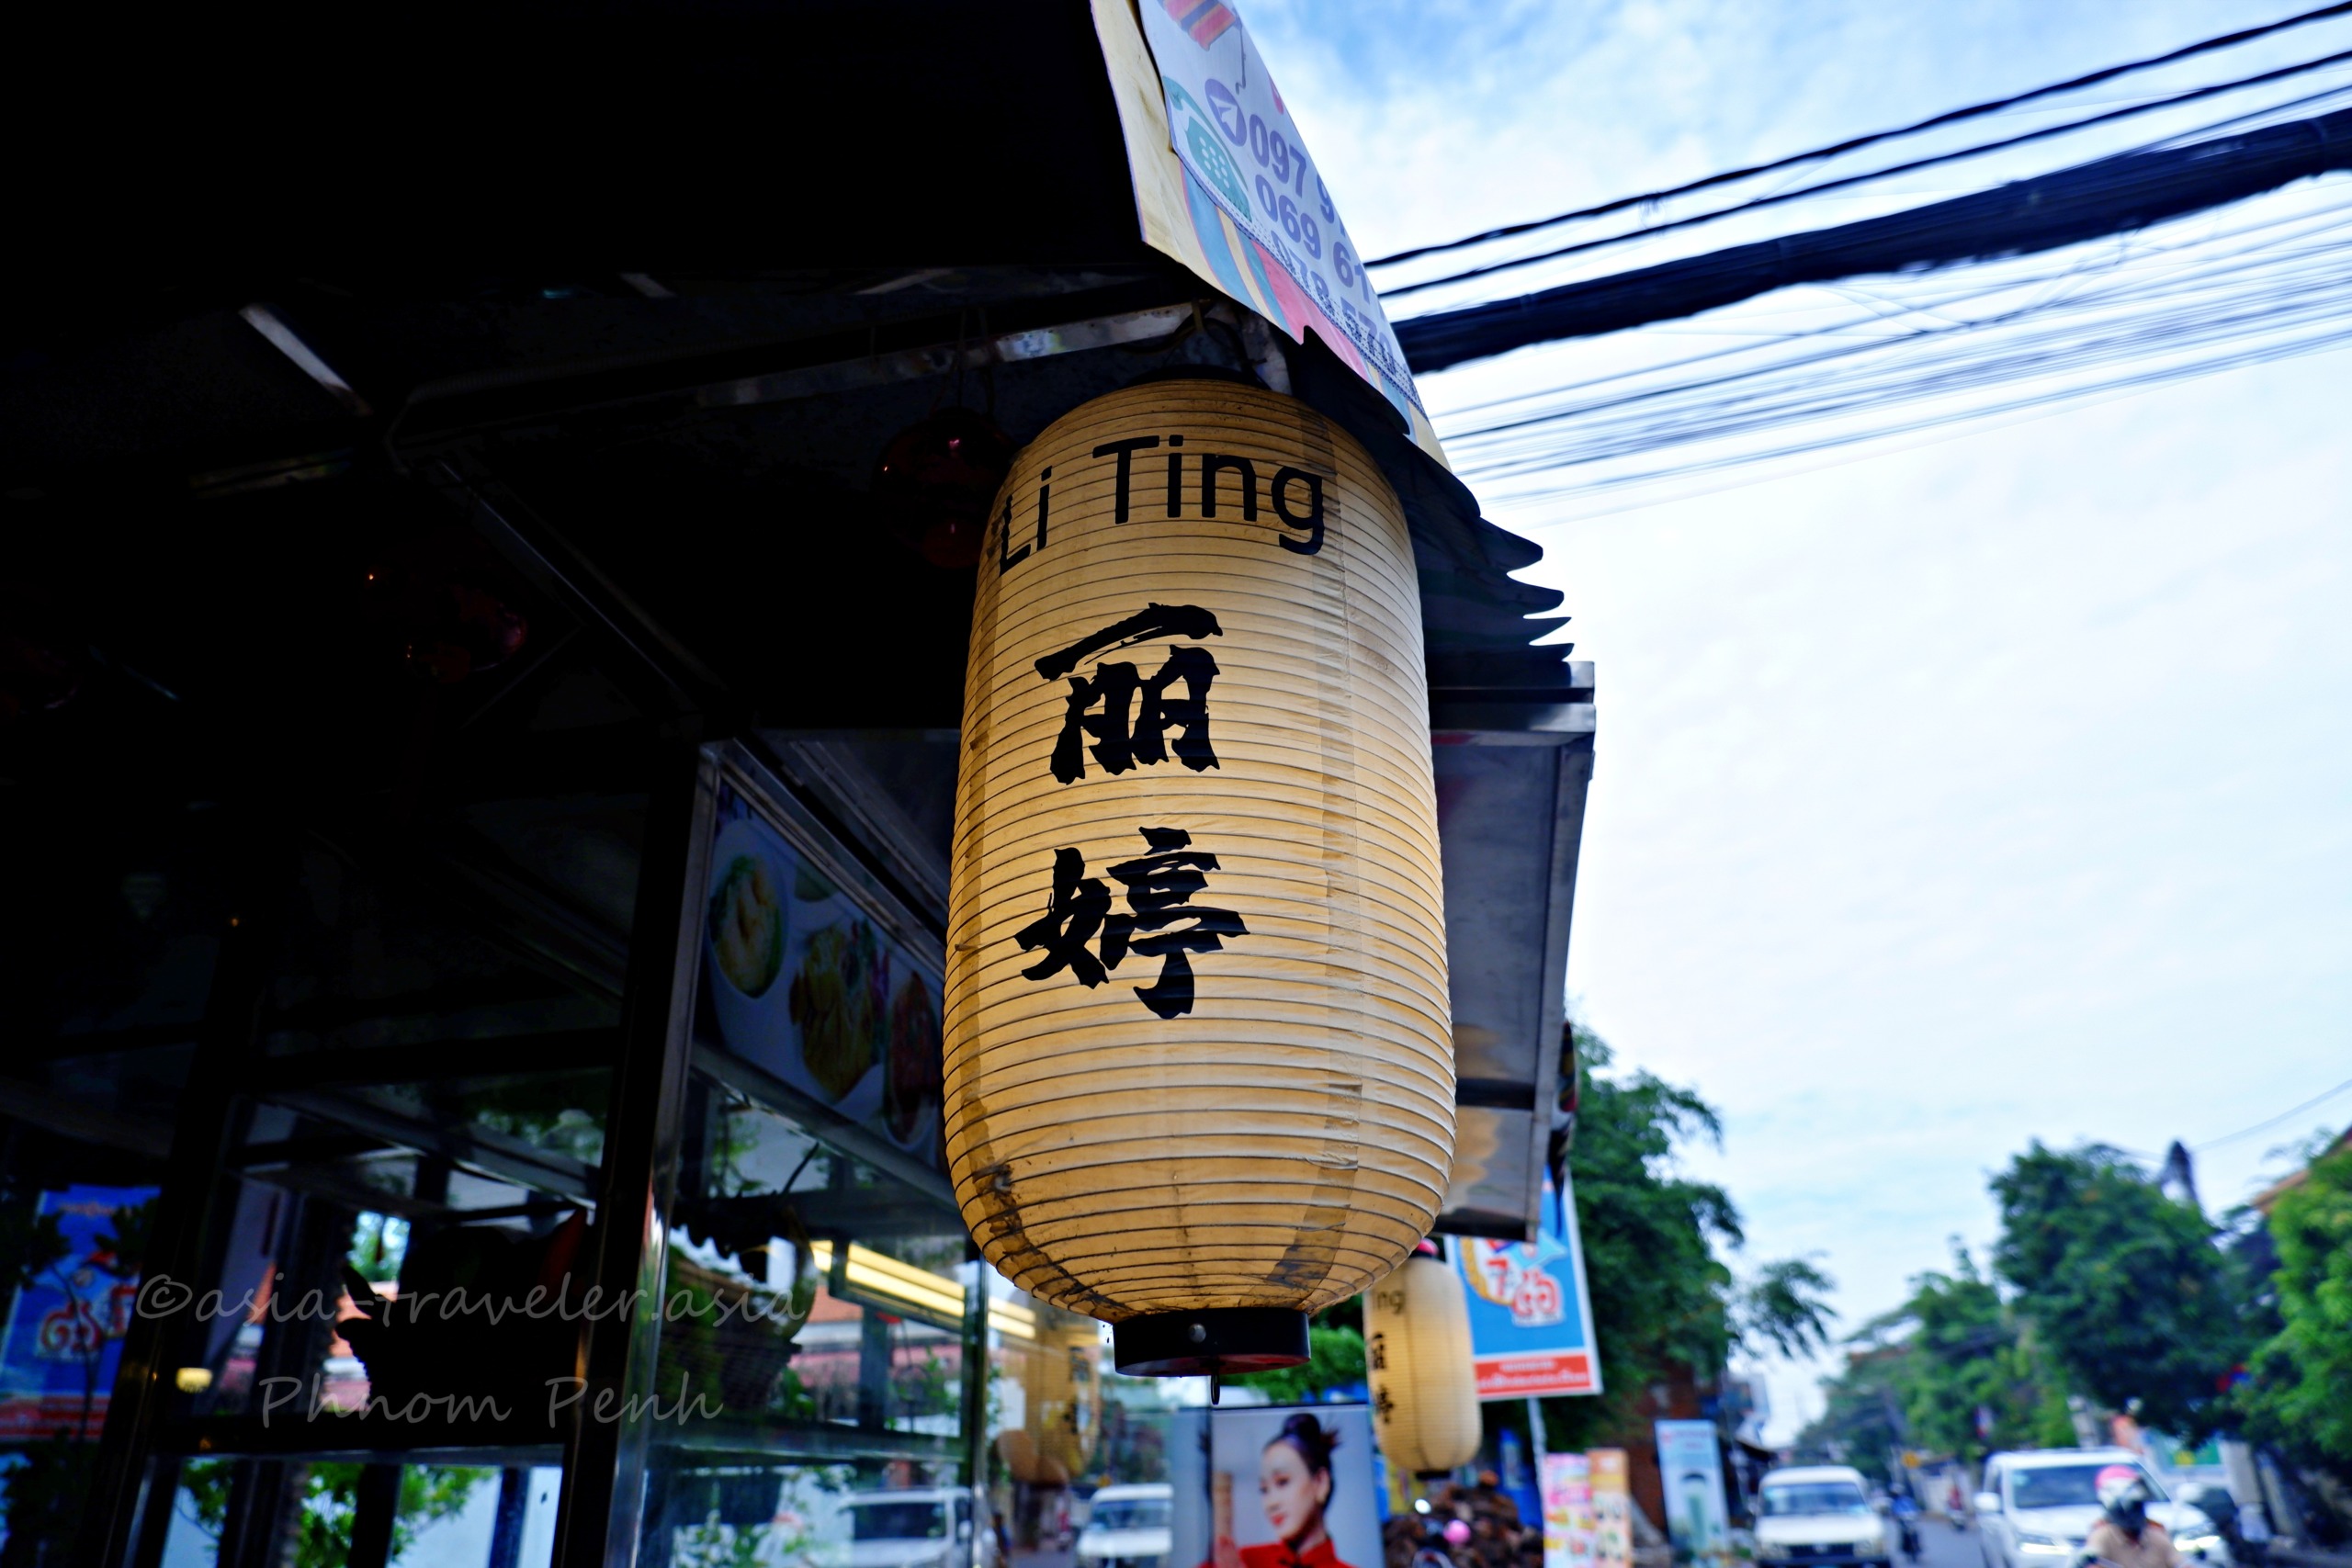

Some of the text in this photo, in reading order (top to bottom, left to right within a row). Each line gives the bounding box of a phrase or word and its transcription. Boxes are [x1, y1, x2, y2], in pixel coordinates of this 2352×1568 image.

[1250, 114, 1306, 198] 097
[1255, 175, 1385, 320] 069 61
[999, 434, 1325, 577] Li Ting
[1014, 603, 1250, 1020] 丽婷
